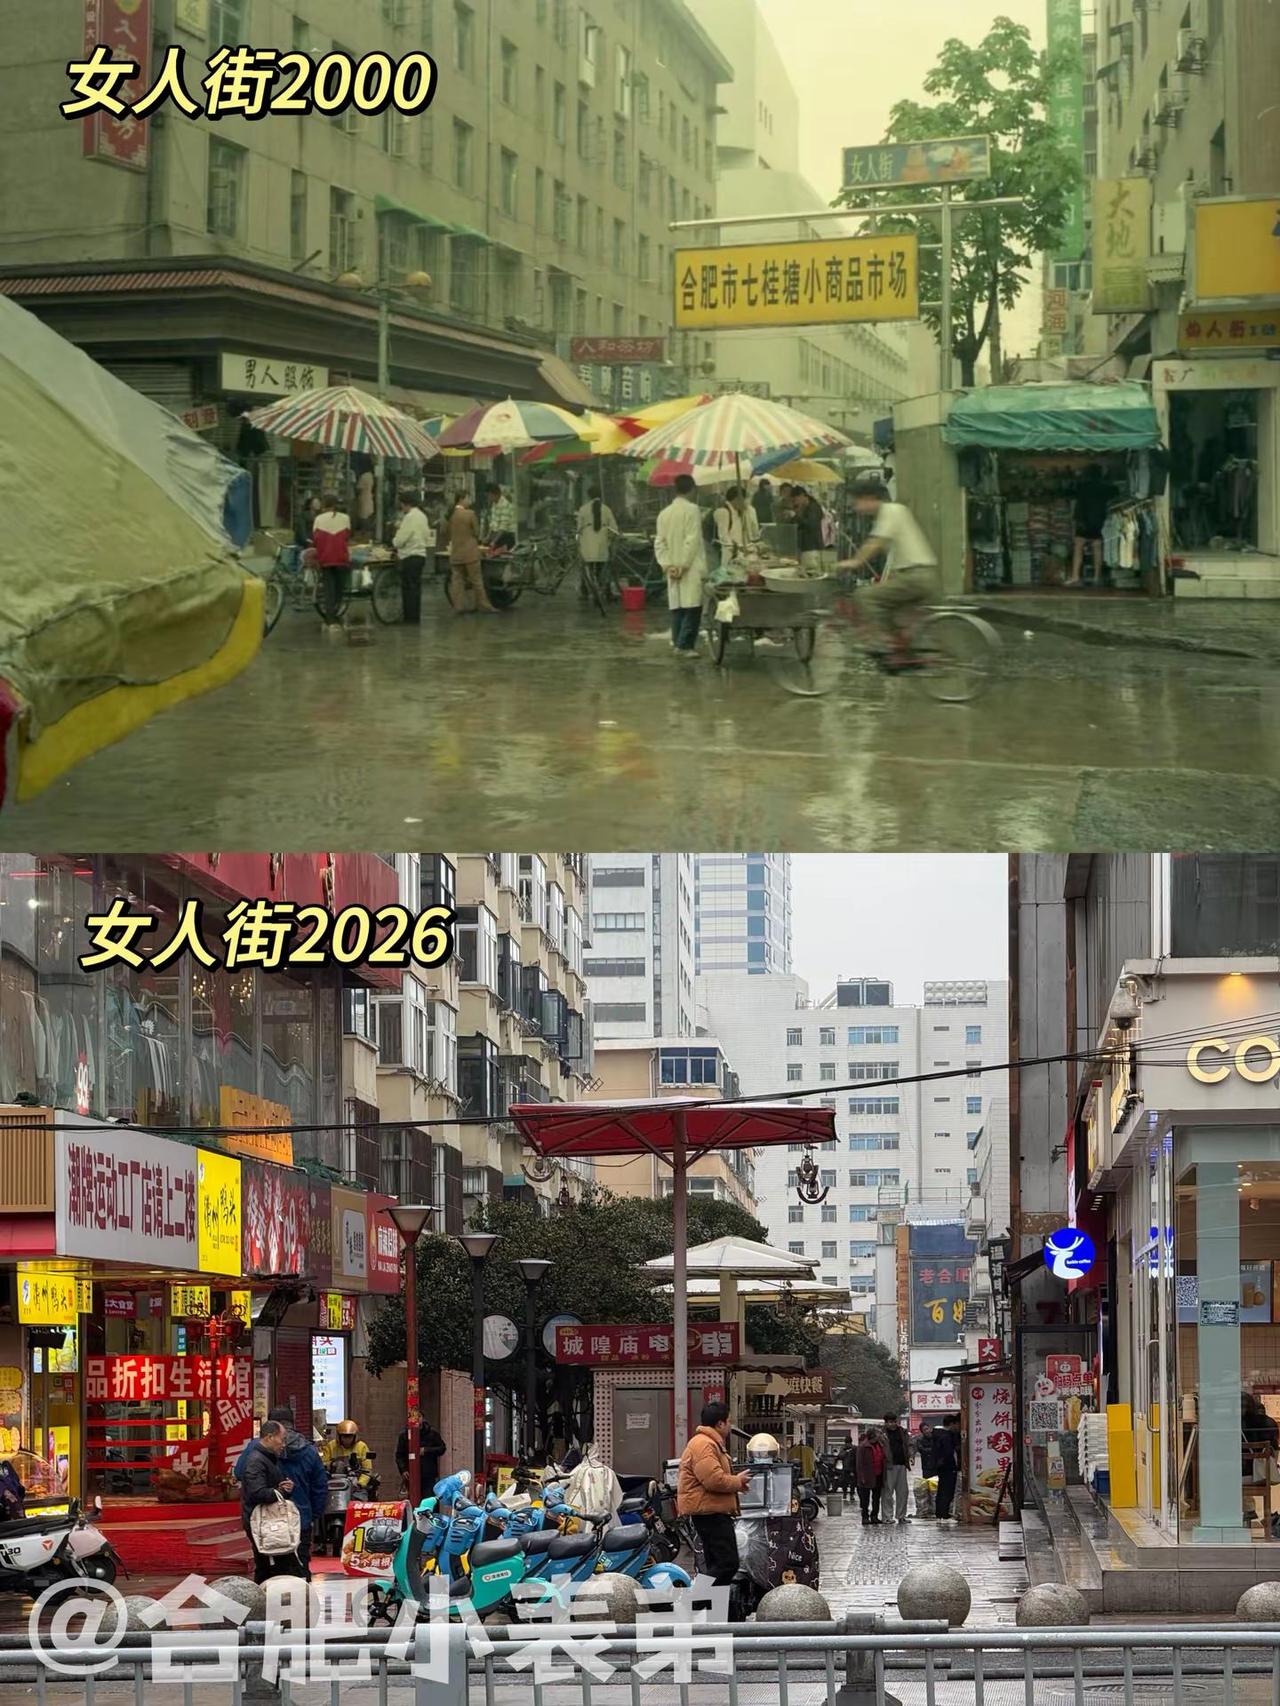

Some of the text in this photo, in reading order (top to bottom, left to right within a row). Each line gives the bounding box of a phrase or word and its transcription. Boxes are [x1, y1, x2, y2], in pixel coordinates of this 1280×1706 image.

[849, 152, 893, 182] 女人街
[680, 251, 908, 311] 合肥市七桂塘小商品市场
[68, 1143, 196, 1243] 潮牌运动工厂店请上二楼
[86, 1357, 251, 1399] 品折扣生活馆
